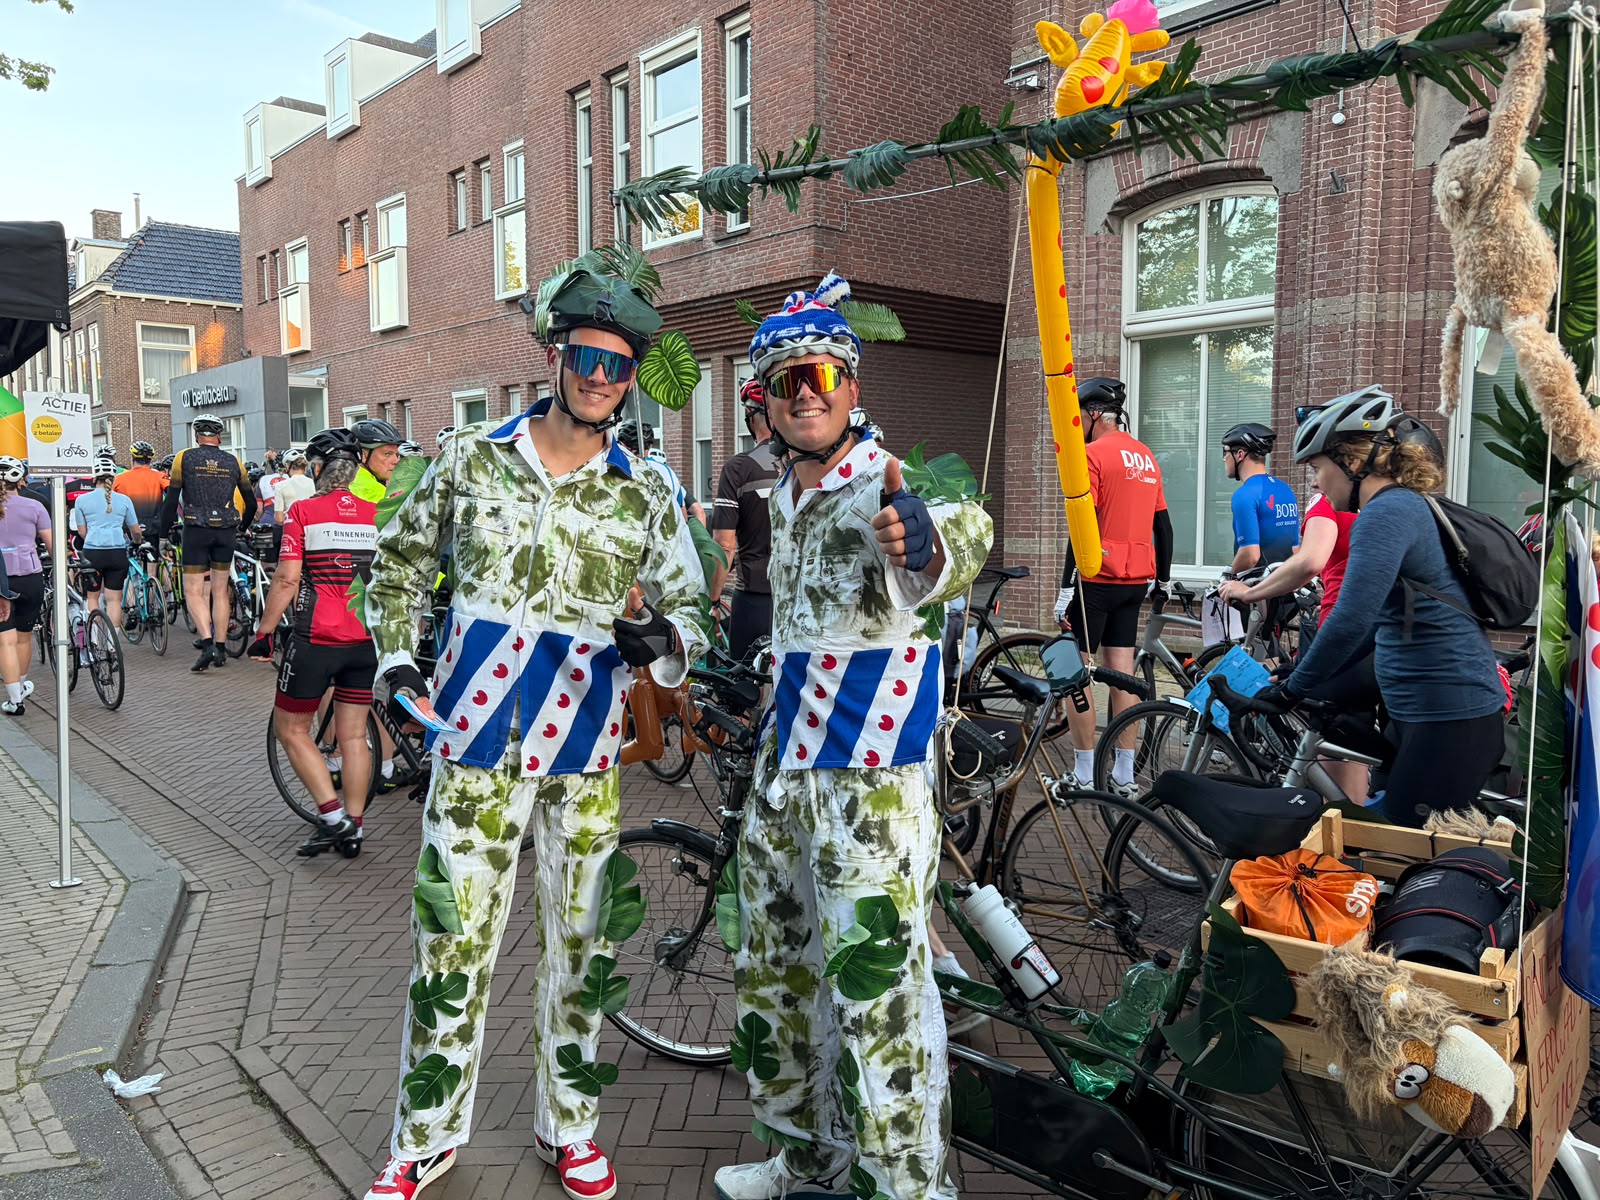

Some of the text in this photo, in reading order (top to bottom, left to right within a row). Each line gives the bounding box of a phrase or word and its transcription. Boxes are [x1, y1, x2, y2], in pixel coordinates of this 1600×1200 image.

[41, 396, 87, 414] ACTIE!
[1119, 449, 1156, 473] DOA
[1533, 1118, 1547, 1183] DE
